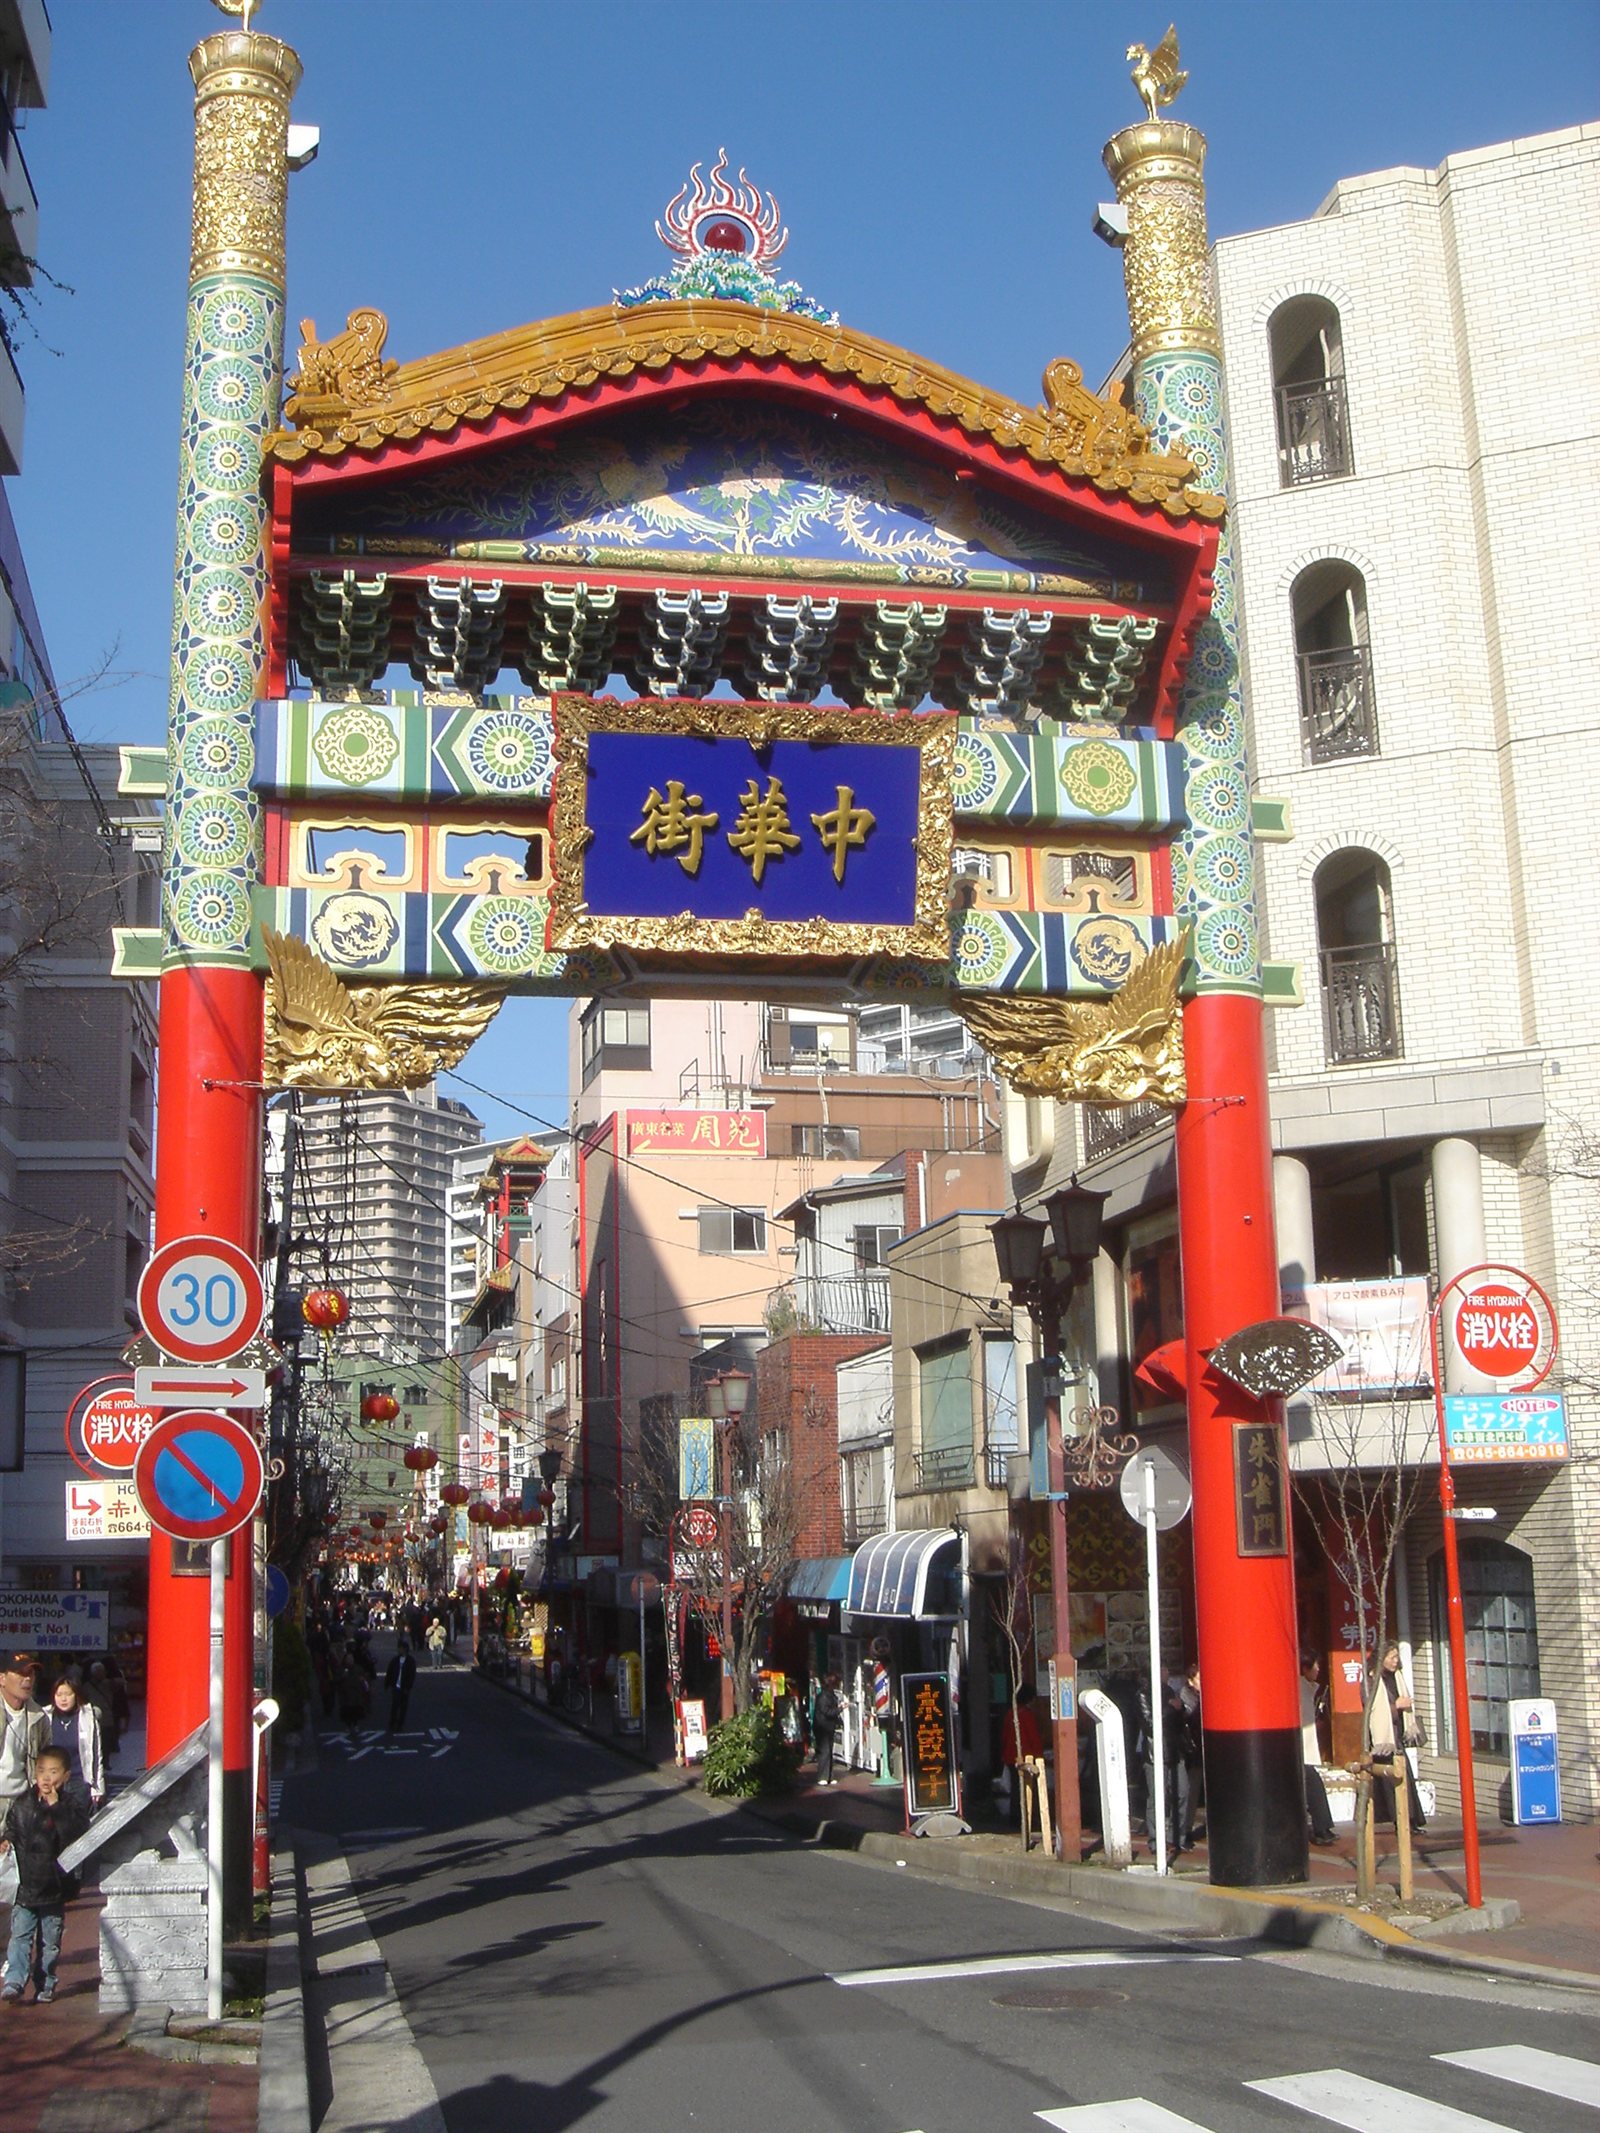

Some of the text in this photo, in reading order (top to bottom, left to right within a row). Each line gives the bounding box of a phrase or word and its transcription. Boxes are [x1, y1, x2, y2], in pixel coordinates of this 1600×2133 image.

[631, 1121, 686, 1136] 廣東名菜
[169, 1273, 238, 1328] 30
[1467, 1295, 1524, 1307] FIRE HYDRANT
[1461, 1312, 1535, 1349] 消火栓
[96, 1399, 148, 1410] FIRE HYDRA
[1452, 1399, 1552, 1412] ニュー HOTEL
[90, 1412, 153, 1445] 消火栓
[1243, 1432, 1277, 1547] 朱雀門
